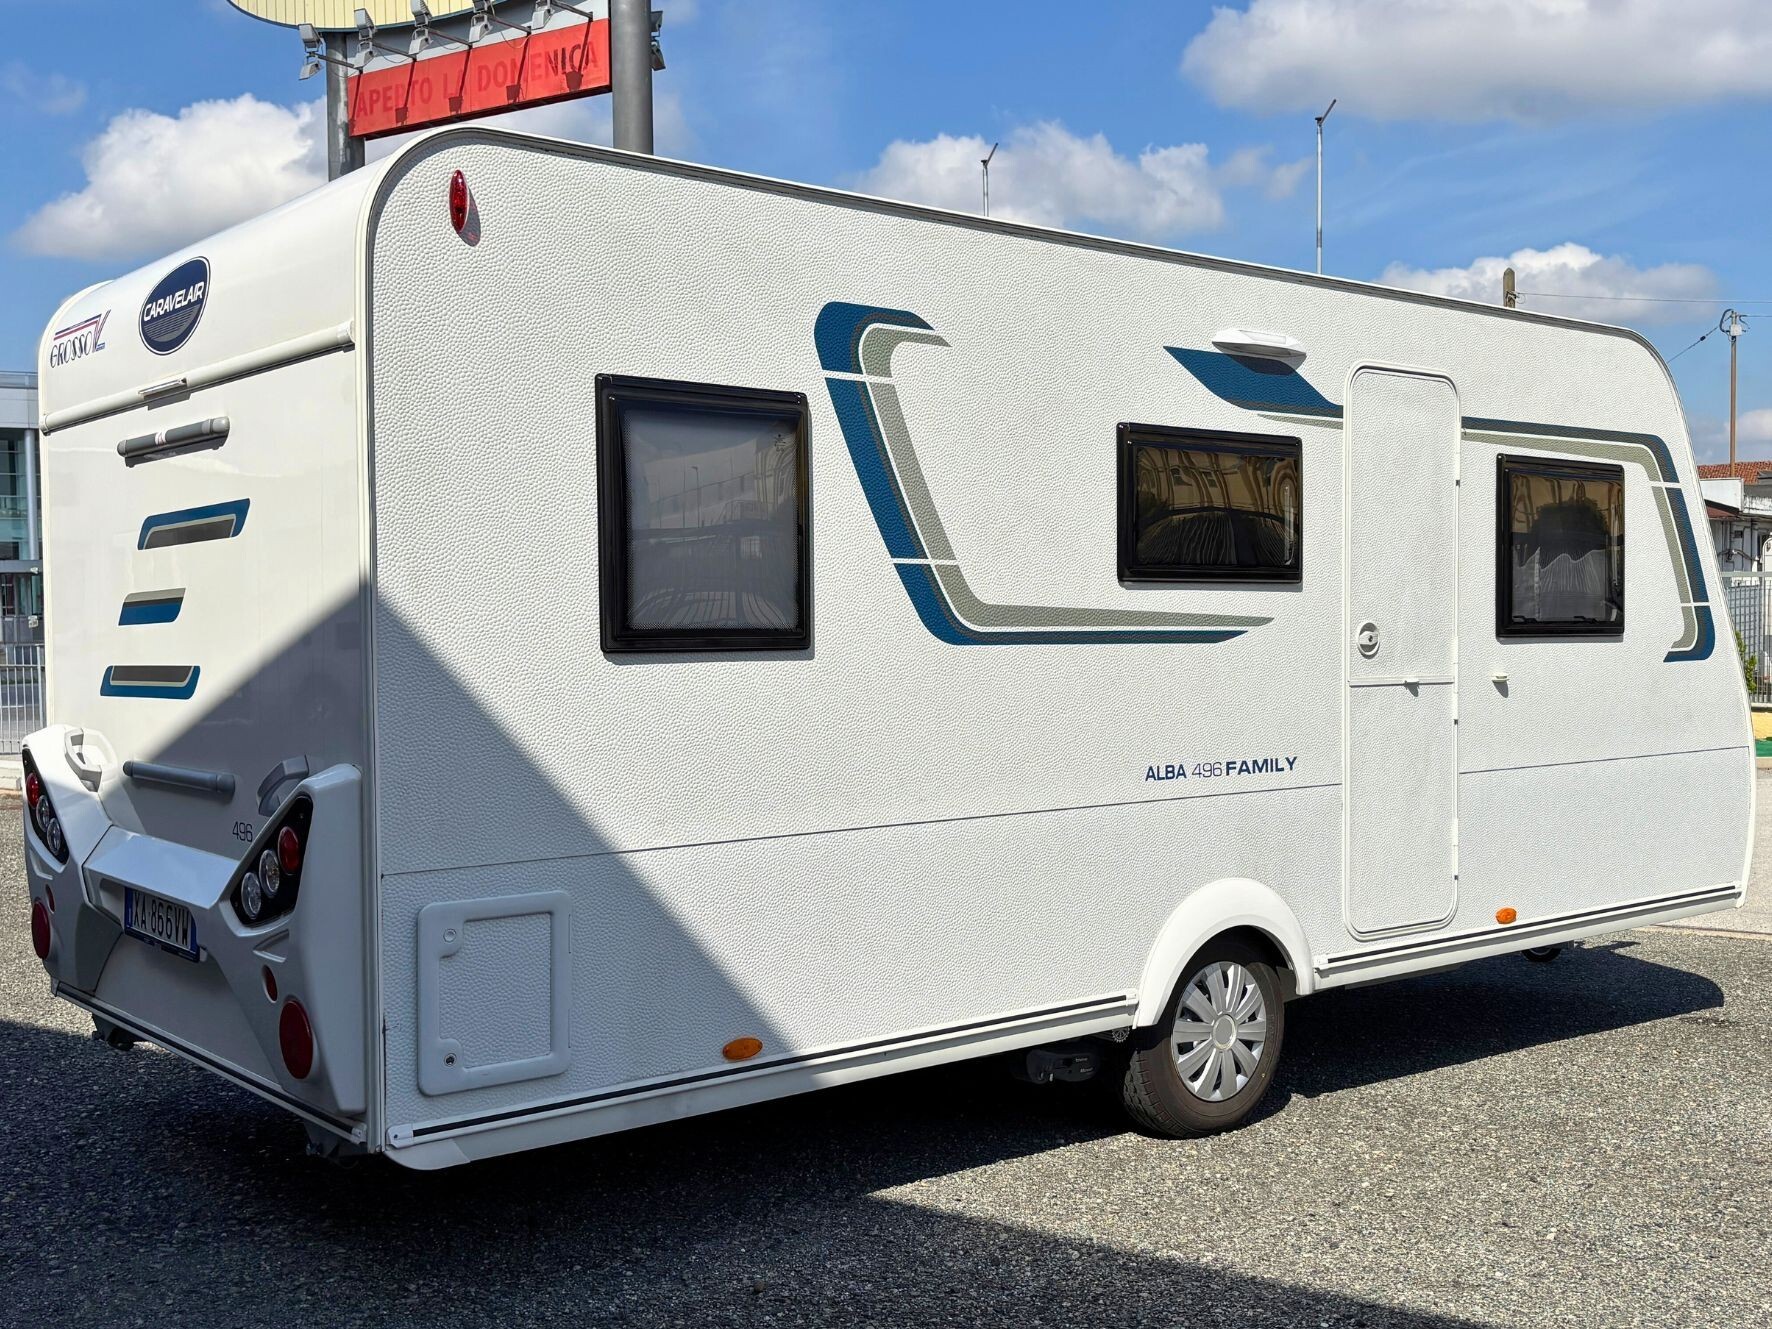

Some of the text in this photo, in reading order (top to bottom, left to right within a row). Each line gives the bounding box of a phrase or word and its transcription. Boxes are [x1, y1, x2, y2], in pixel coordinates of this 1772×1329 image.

[477, 41, 599, 91] DOMENICA
[143, 281, 204, 321] CARAVELAIR
[1145, 756, 1298, 782] ALBA 496 FAMILY
[232, 821, 253, 842] 496
